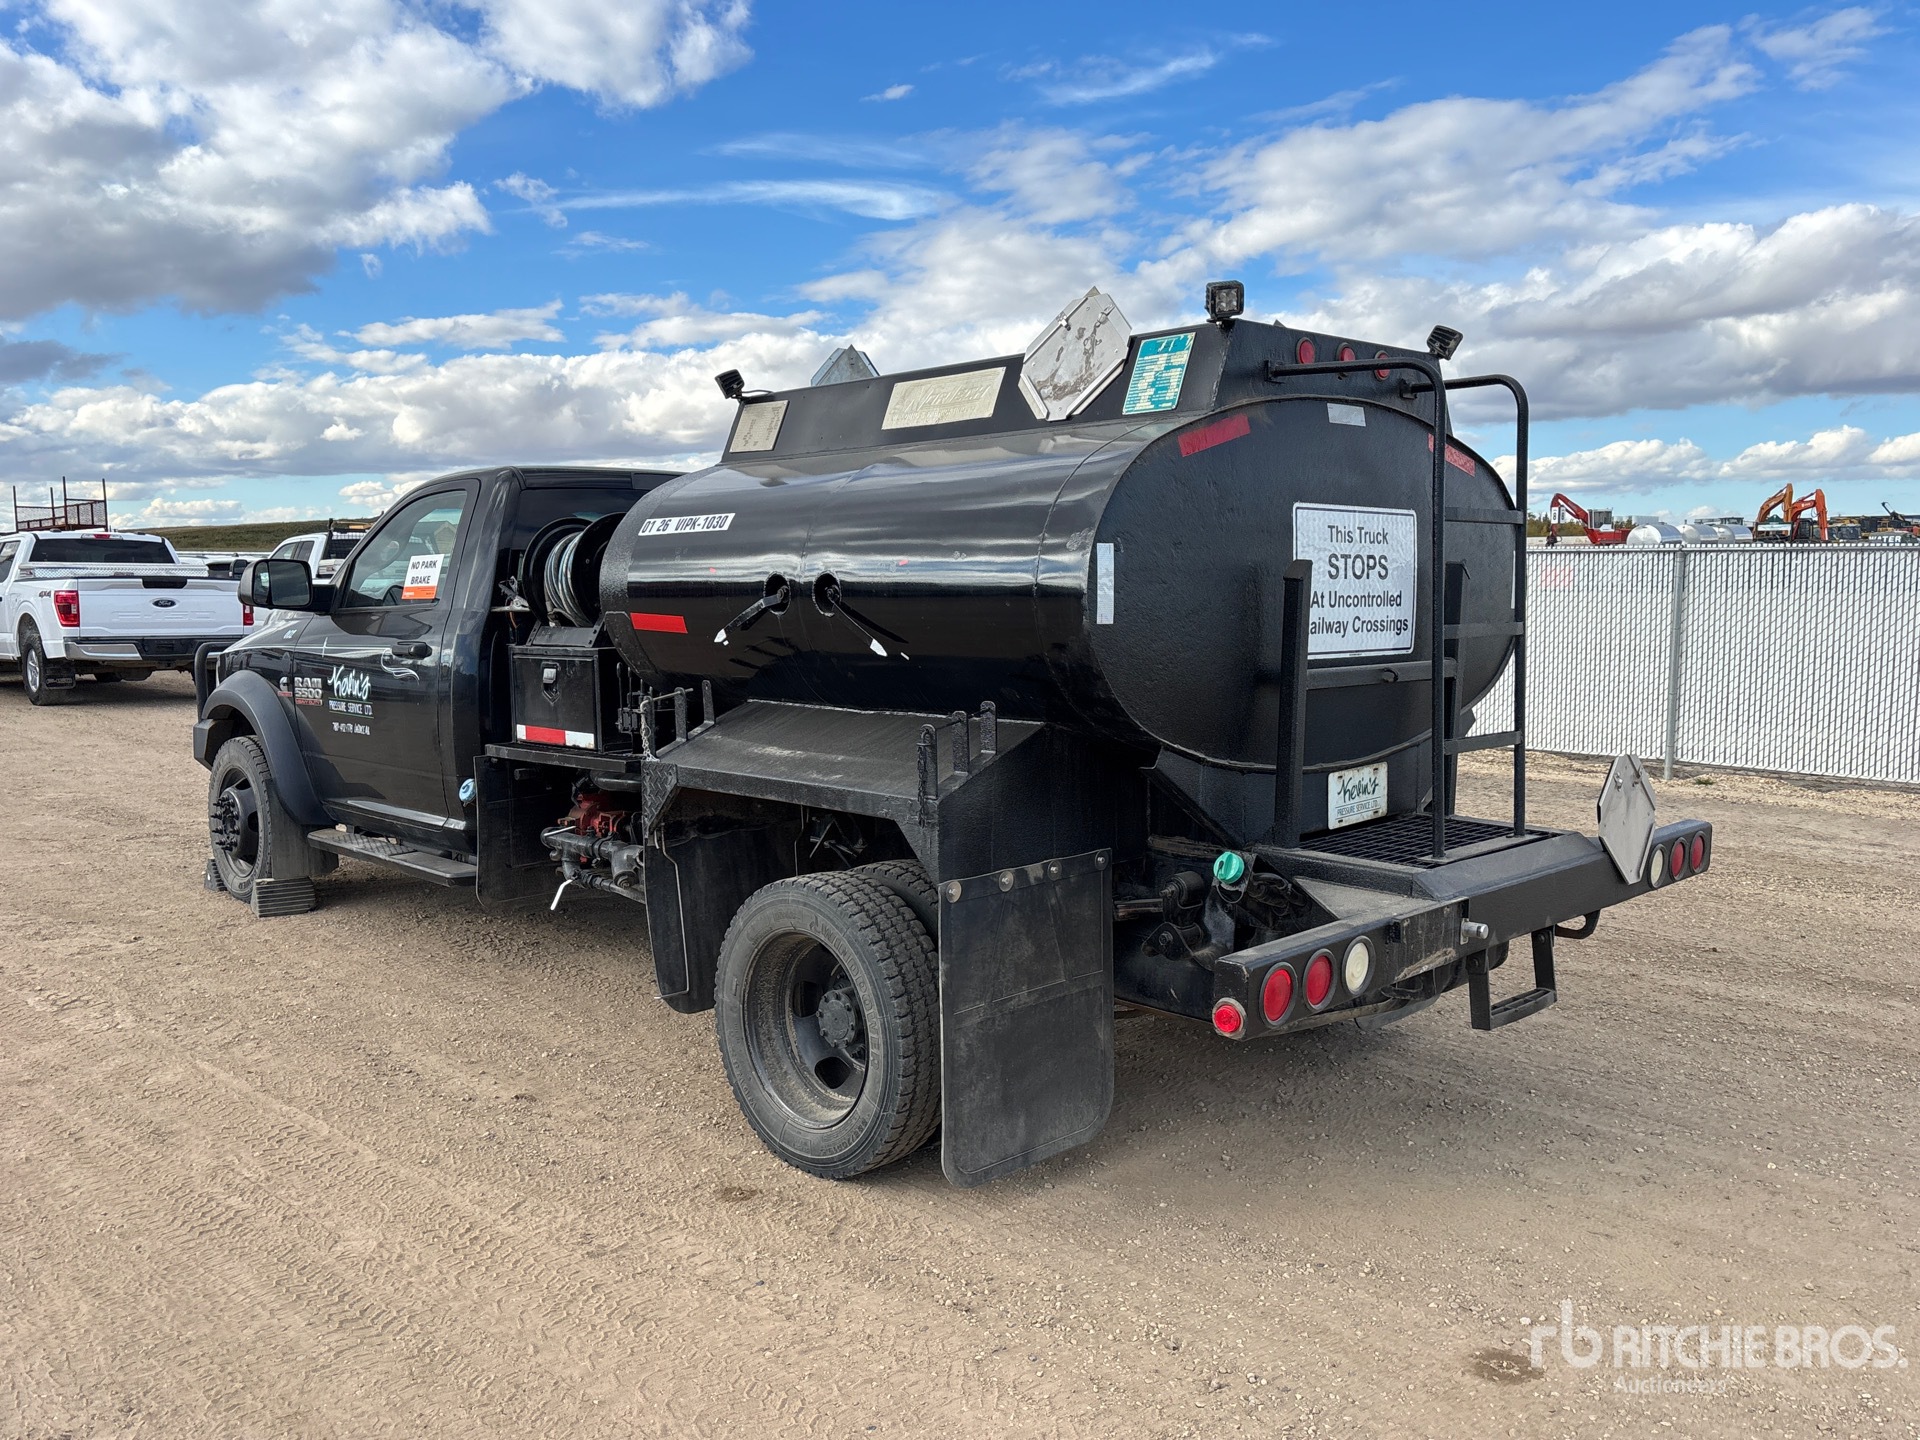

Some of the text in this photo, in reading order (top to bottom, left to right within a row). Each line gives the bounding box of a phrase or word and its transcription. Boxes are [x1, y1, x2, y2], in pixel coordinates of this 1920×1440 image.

[641, 515, 729, 533] 01 26 VIPK-1030
[1327, 525, 1389, 545] This Truck
[411, 560, 438, 570] NO PARK
[1327, 553, 1389, 580] STOPS
[411, 576, 431, 585] BRAKE
[1310, 590, 1402, 609] At Uncontrolled
[1309, 615, 1409, 638] ailway Crossings
[294, 676, 322, 688] RAM
[327, 664, 372, 700] Kevin's
[294, 687, 322, 699] 5500
[328, 700, 347, 712] PRESSURE
[347, 702, 363, 714] SERVICE
[1337, 776, 1379, 803] Kevin's
[1337, 804, 1355, 817] PRESSURE
[1356, 801, 1371, 812] SERVICE
